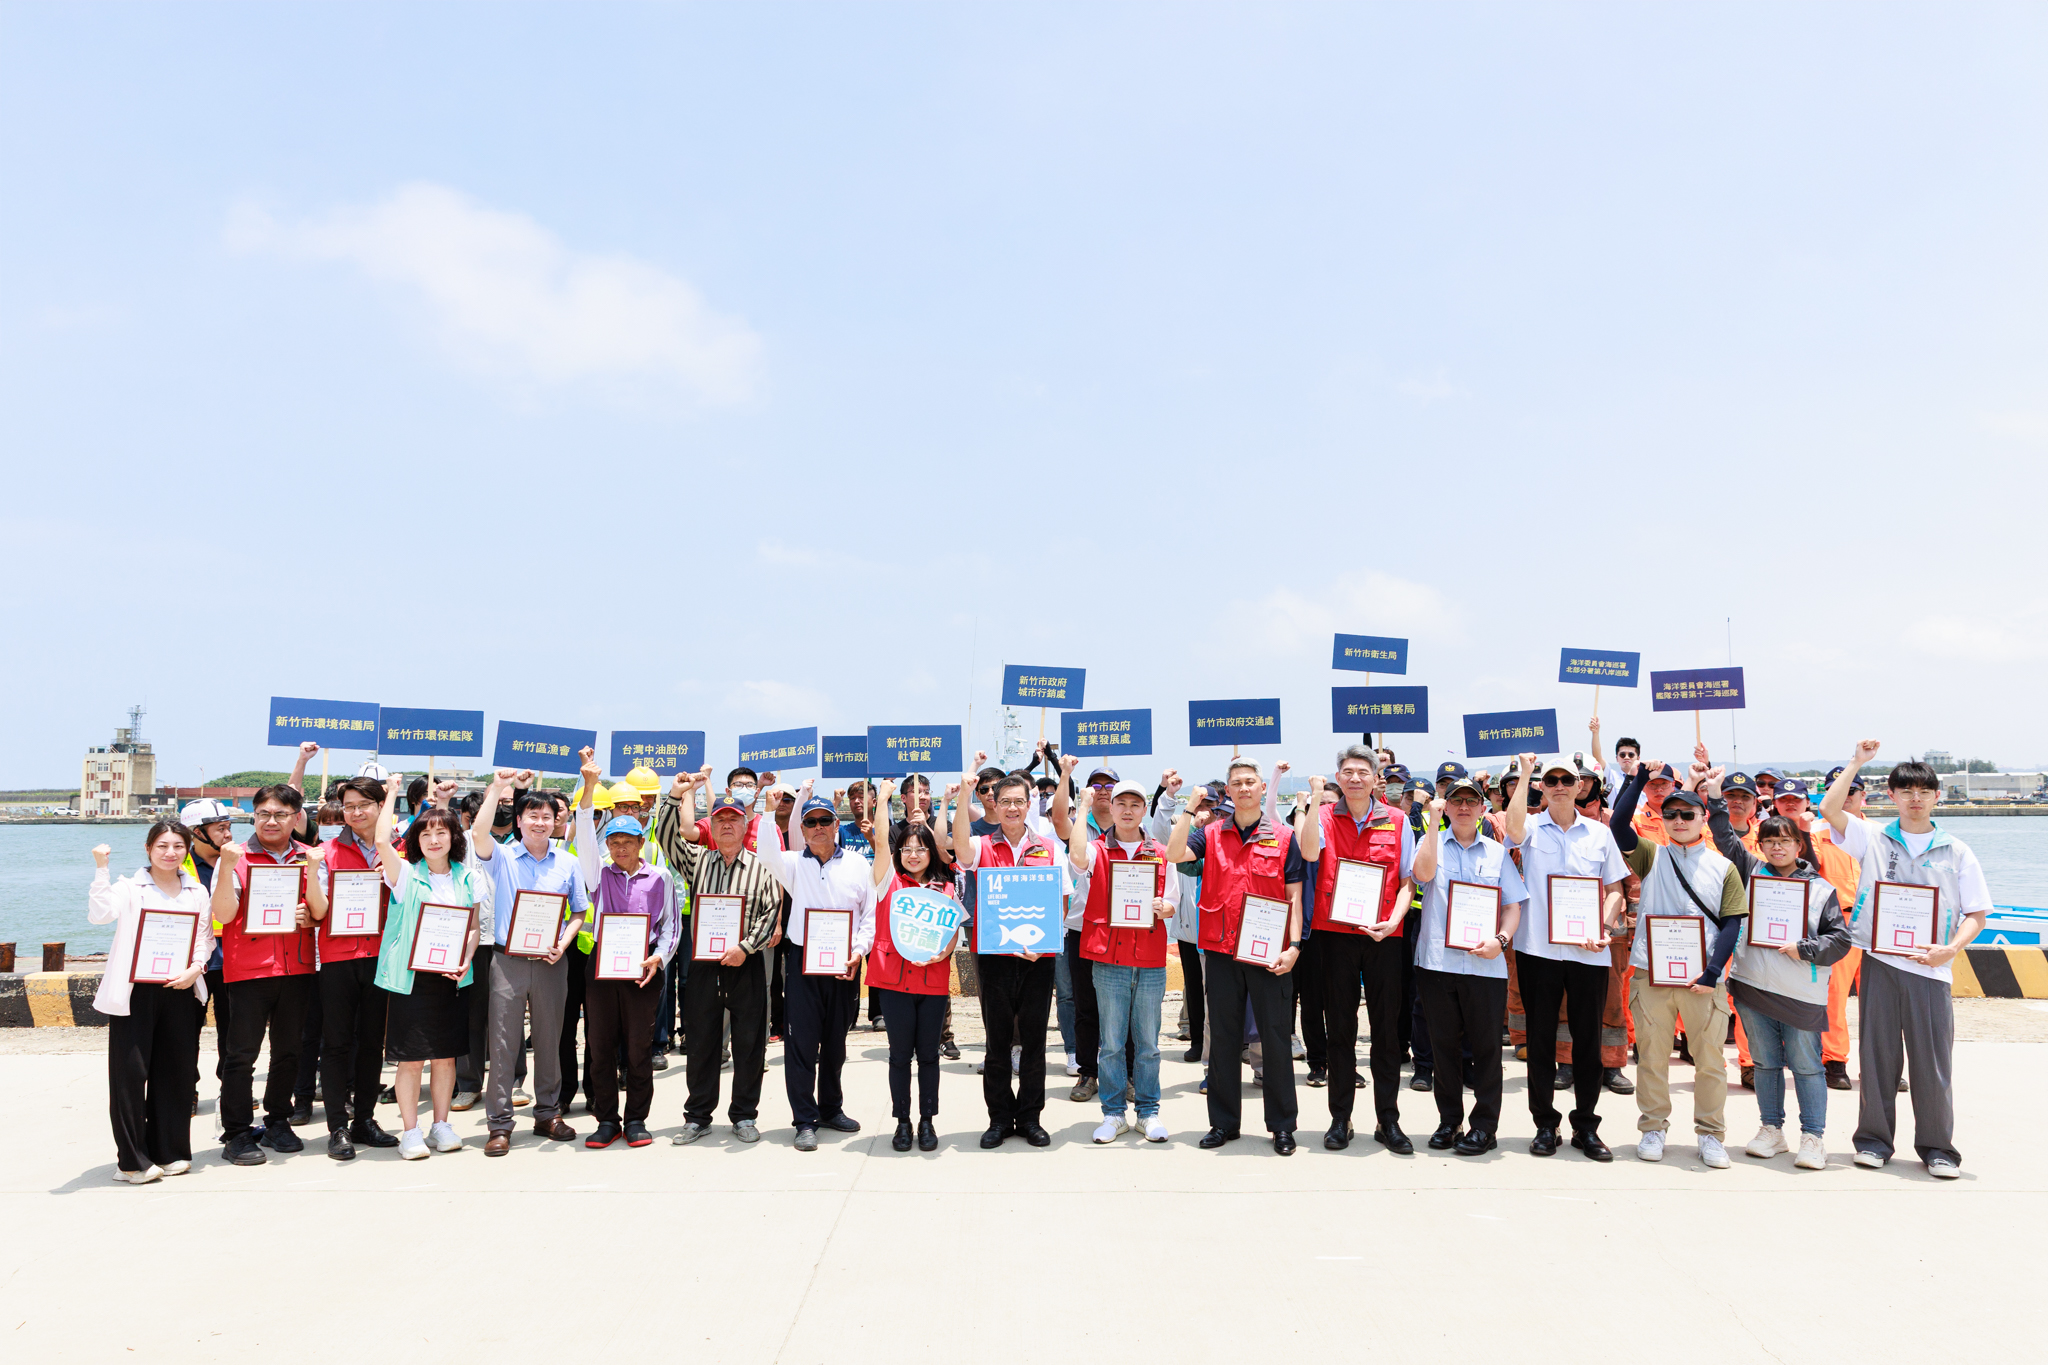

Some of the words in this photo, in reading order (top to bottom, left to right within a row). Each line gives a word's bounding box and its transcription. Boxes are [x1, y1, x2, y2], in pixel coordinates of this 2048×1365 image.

[1344, 648, 1397, 660] 新竹市衛生局
[1570, 659, 1626, 669] 海洋委員會海巡署
[1566, 666, 1629, 677] 北部分署第八岸巡隊
[1019, 676, 1067, 687] 新竹市政府
[1663, 680, 1729, 690] 海洋委員會海巡署
[1018, 687, 1066, 699] 城市行銷處
[1656, 689, 1738, 699] 艦隊分署第十二海巡隊
[1347, 703, 1415, 715] 新竹市警察局
[276, 716, 375, 732] 新竹市環境保護局
[1077, 720, 1131, 733] 新竹市政府
[1197, 716, 1274, 728] 新竹市政府交通處
[387, 728, 473, 742] 新竹市環保艦隊
[1479, 726, 1544, 740] 新竹市消防局
[886, 737, 942, 749] 新竹市政府
[1077, 733, 1131, 746] 產業發展處
[512, 740, 571, 757] 新竹區漁會
[622, 744, 688, 756] 台灣中油股份
[741, 744, 816, 762] 新竹市北區區公所
[898, 750, 931, 762] 社會處
[632, 757, 677, 768] 有限公司
[1885, 850, 1899, 880] 社會處
[987, 874, 1003, 892] 14
[1003, 873, 1054, 882] 保育海洋生態
[894, 896, 958, 929] 全方位
[898, 922, 942, 949] 守護
